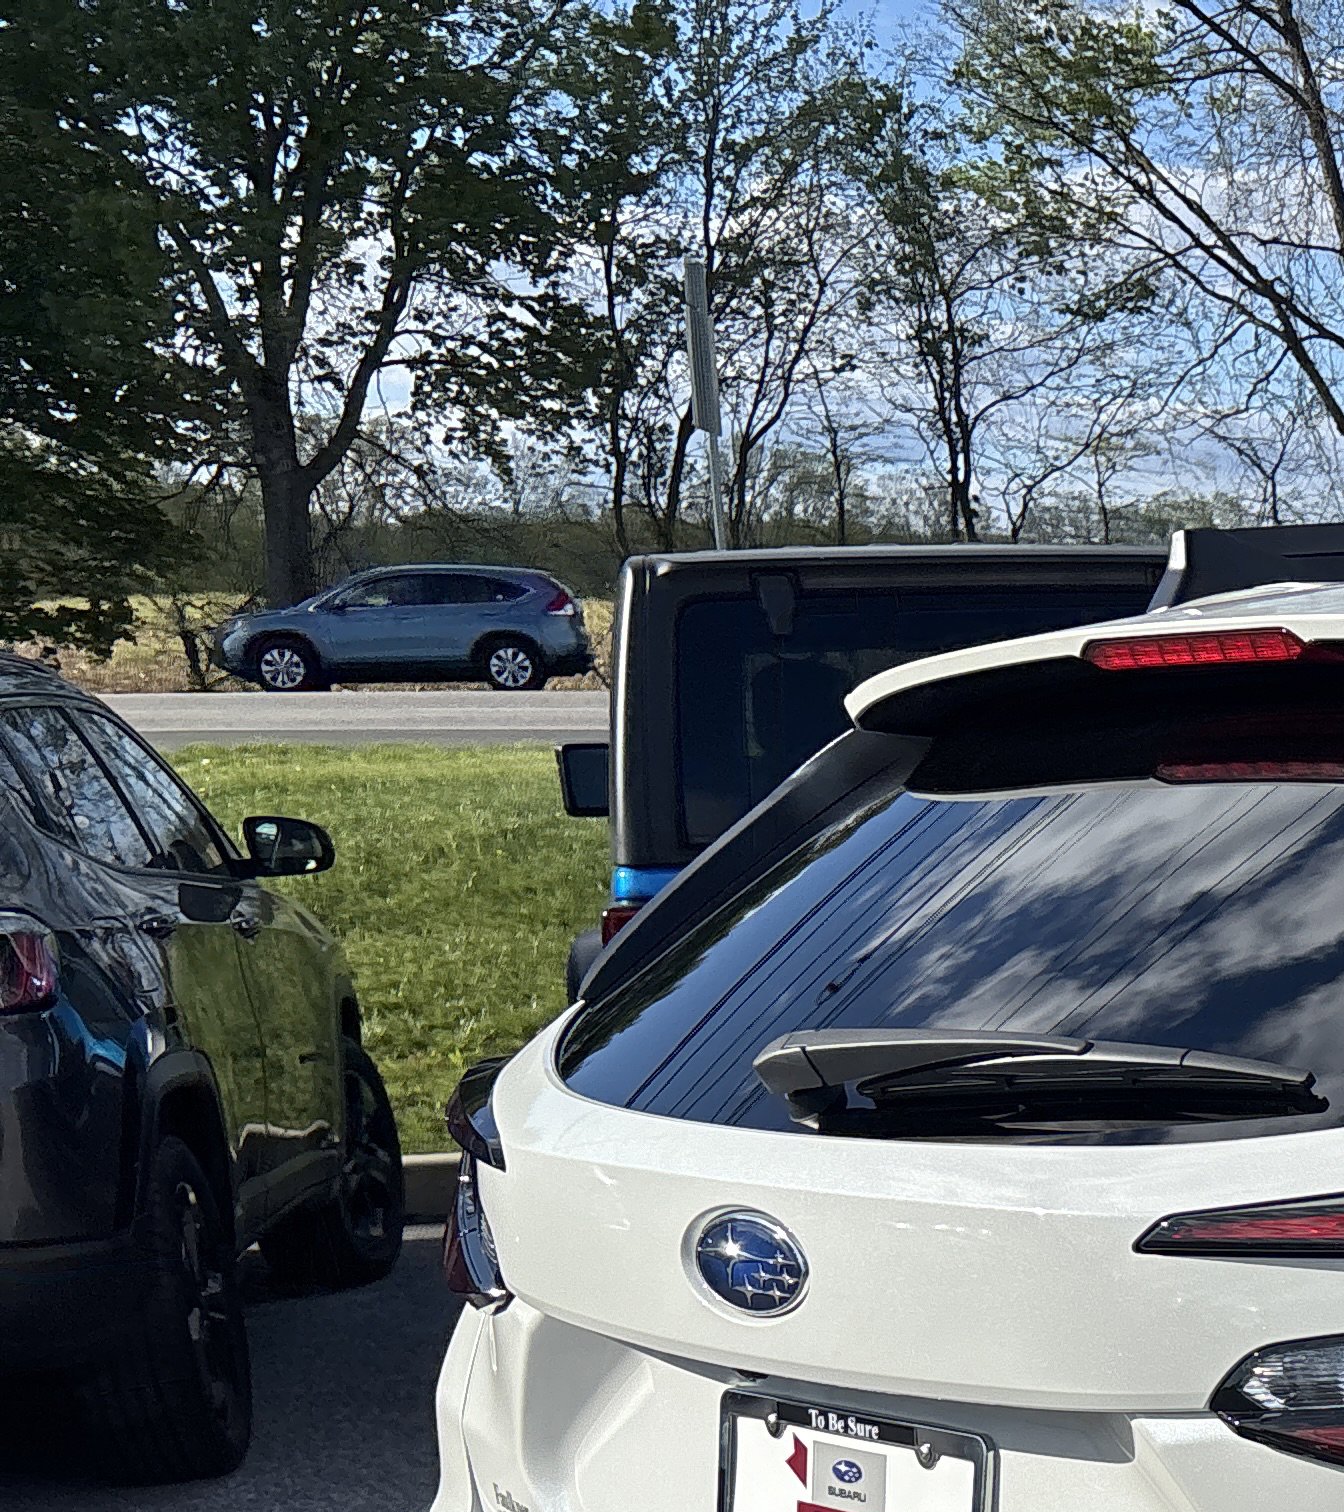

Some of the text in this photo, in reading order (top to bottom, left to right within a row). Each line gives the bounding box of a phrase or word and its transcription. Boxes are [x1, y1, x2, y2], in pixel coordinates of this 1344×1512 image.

[808, 1408, 880, 1440] To Be Sure
[827, 1485, 867, 1503] SUBARU
